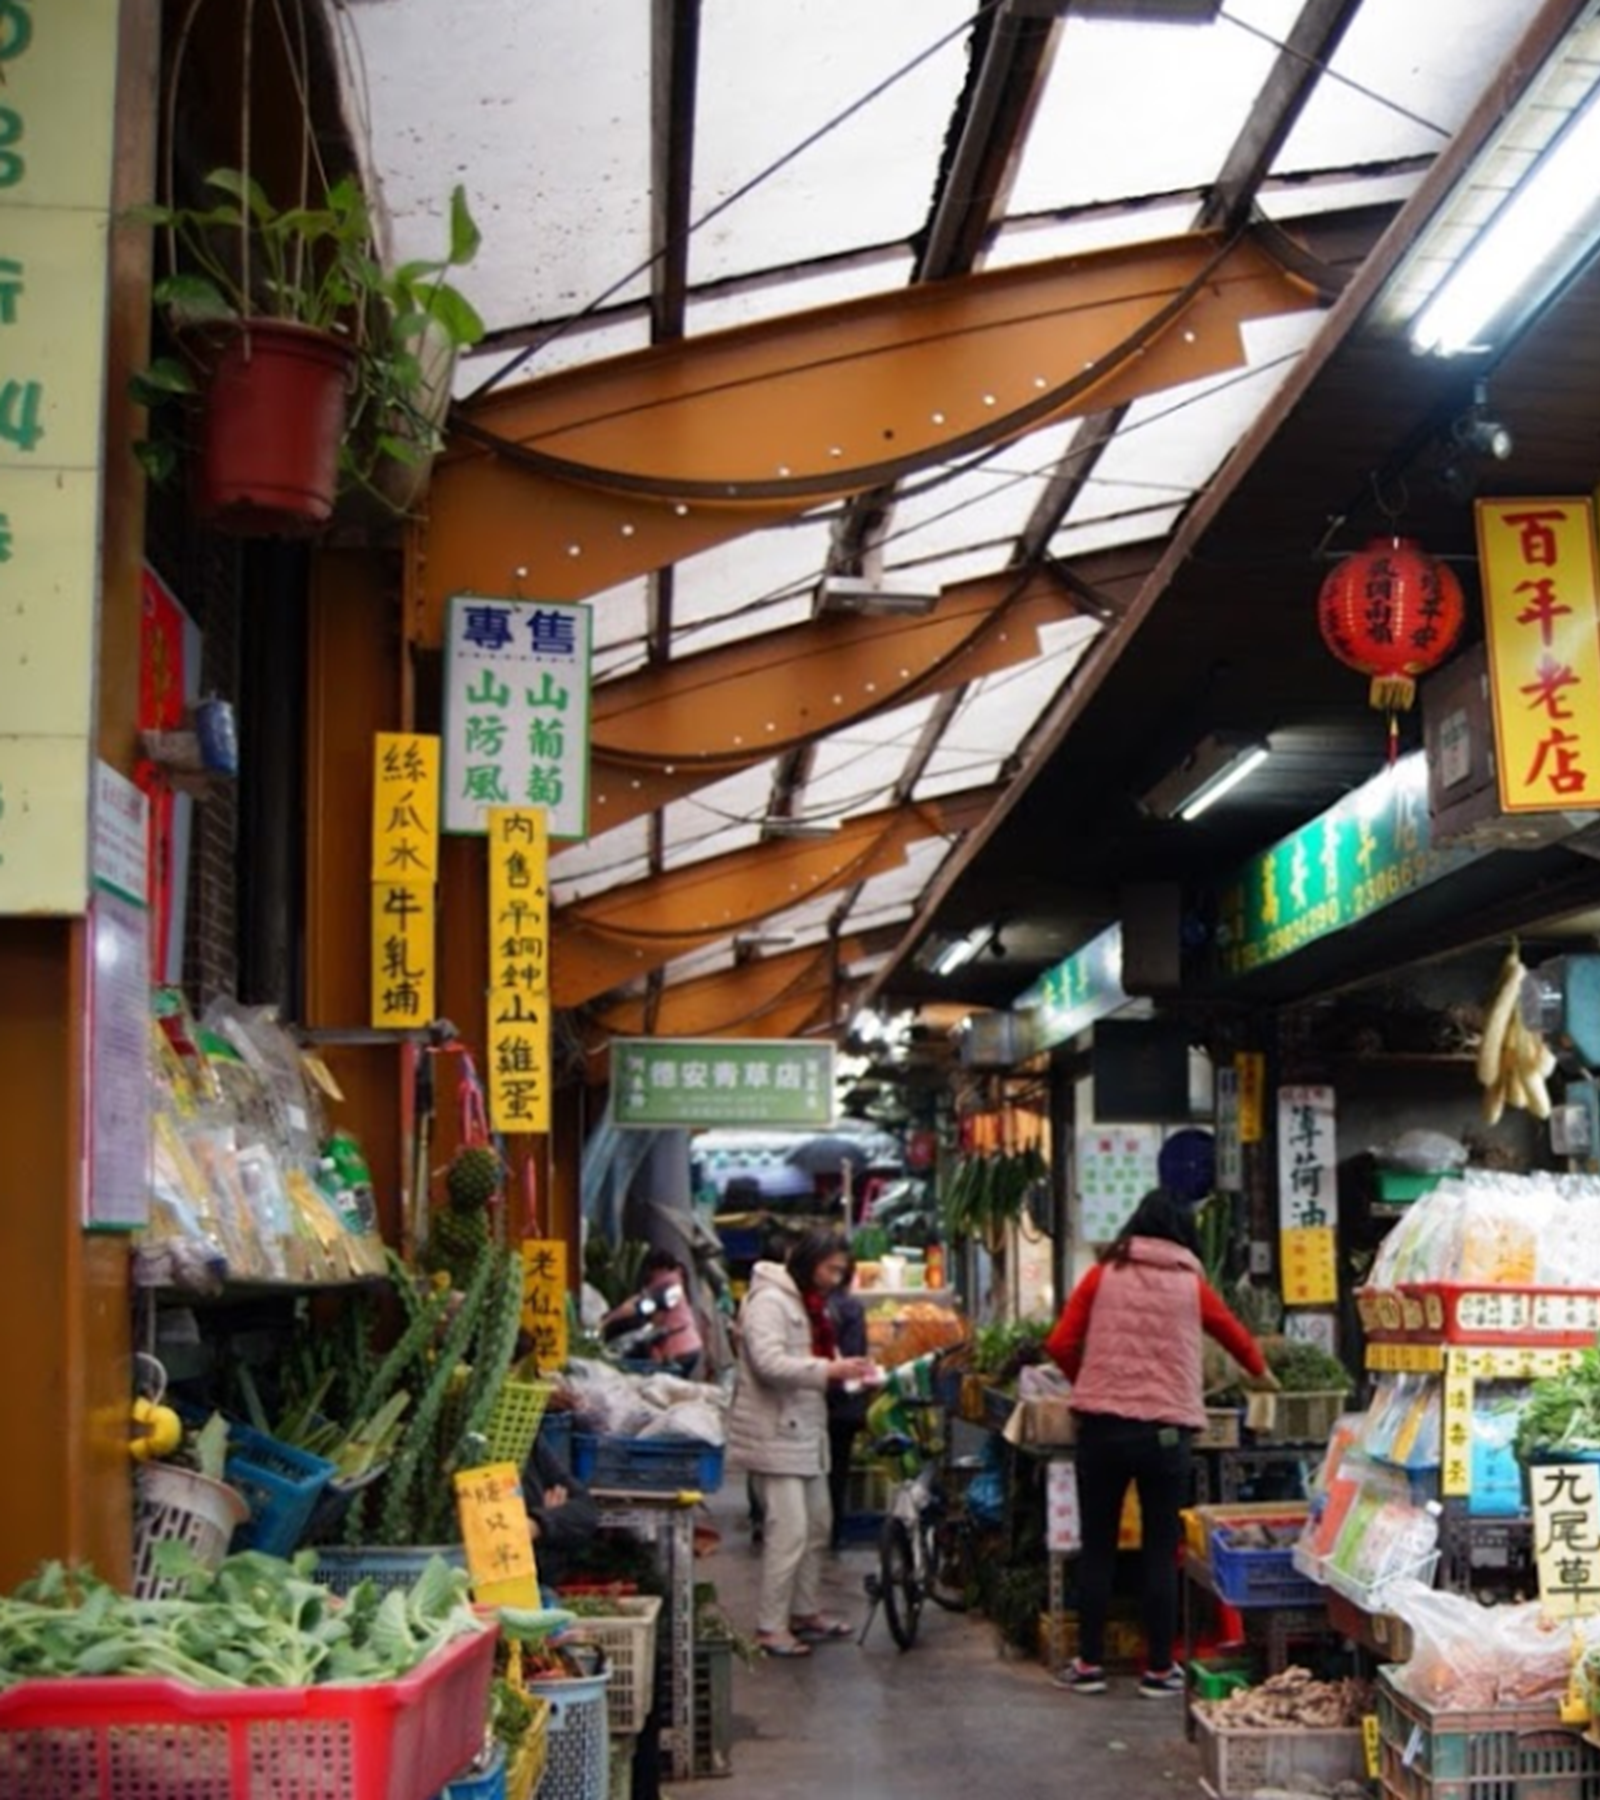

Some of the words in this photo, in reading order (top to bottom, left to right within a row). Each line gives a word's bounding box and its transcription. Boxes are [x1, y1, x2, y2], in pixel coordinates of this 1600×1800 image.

[462, 606, 577, 654] 專售
[1501, 510, 1587, 795] 百年老店
[462, 668, 513, 804] 山防風
[525, 672, 569, 807] 山葡萄
[383, 739, 429, 872] 絲瓜水
